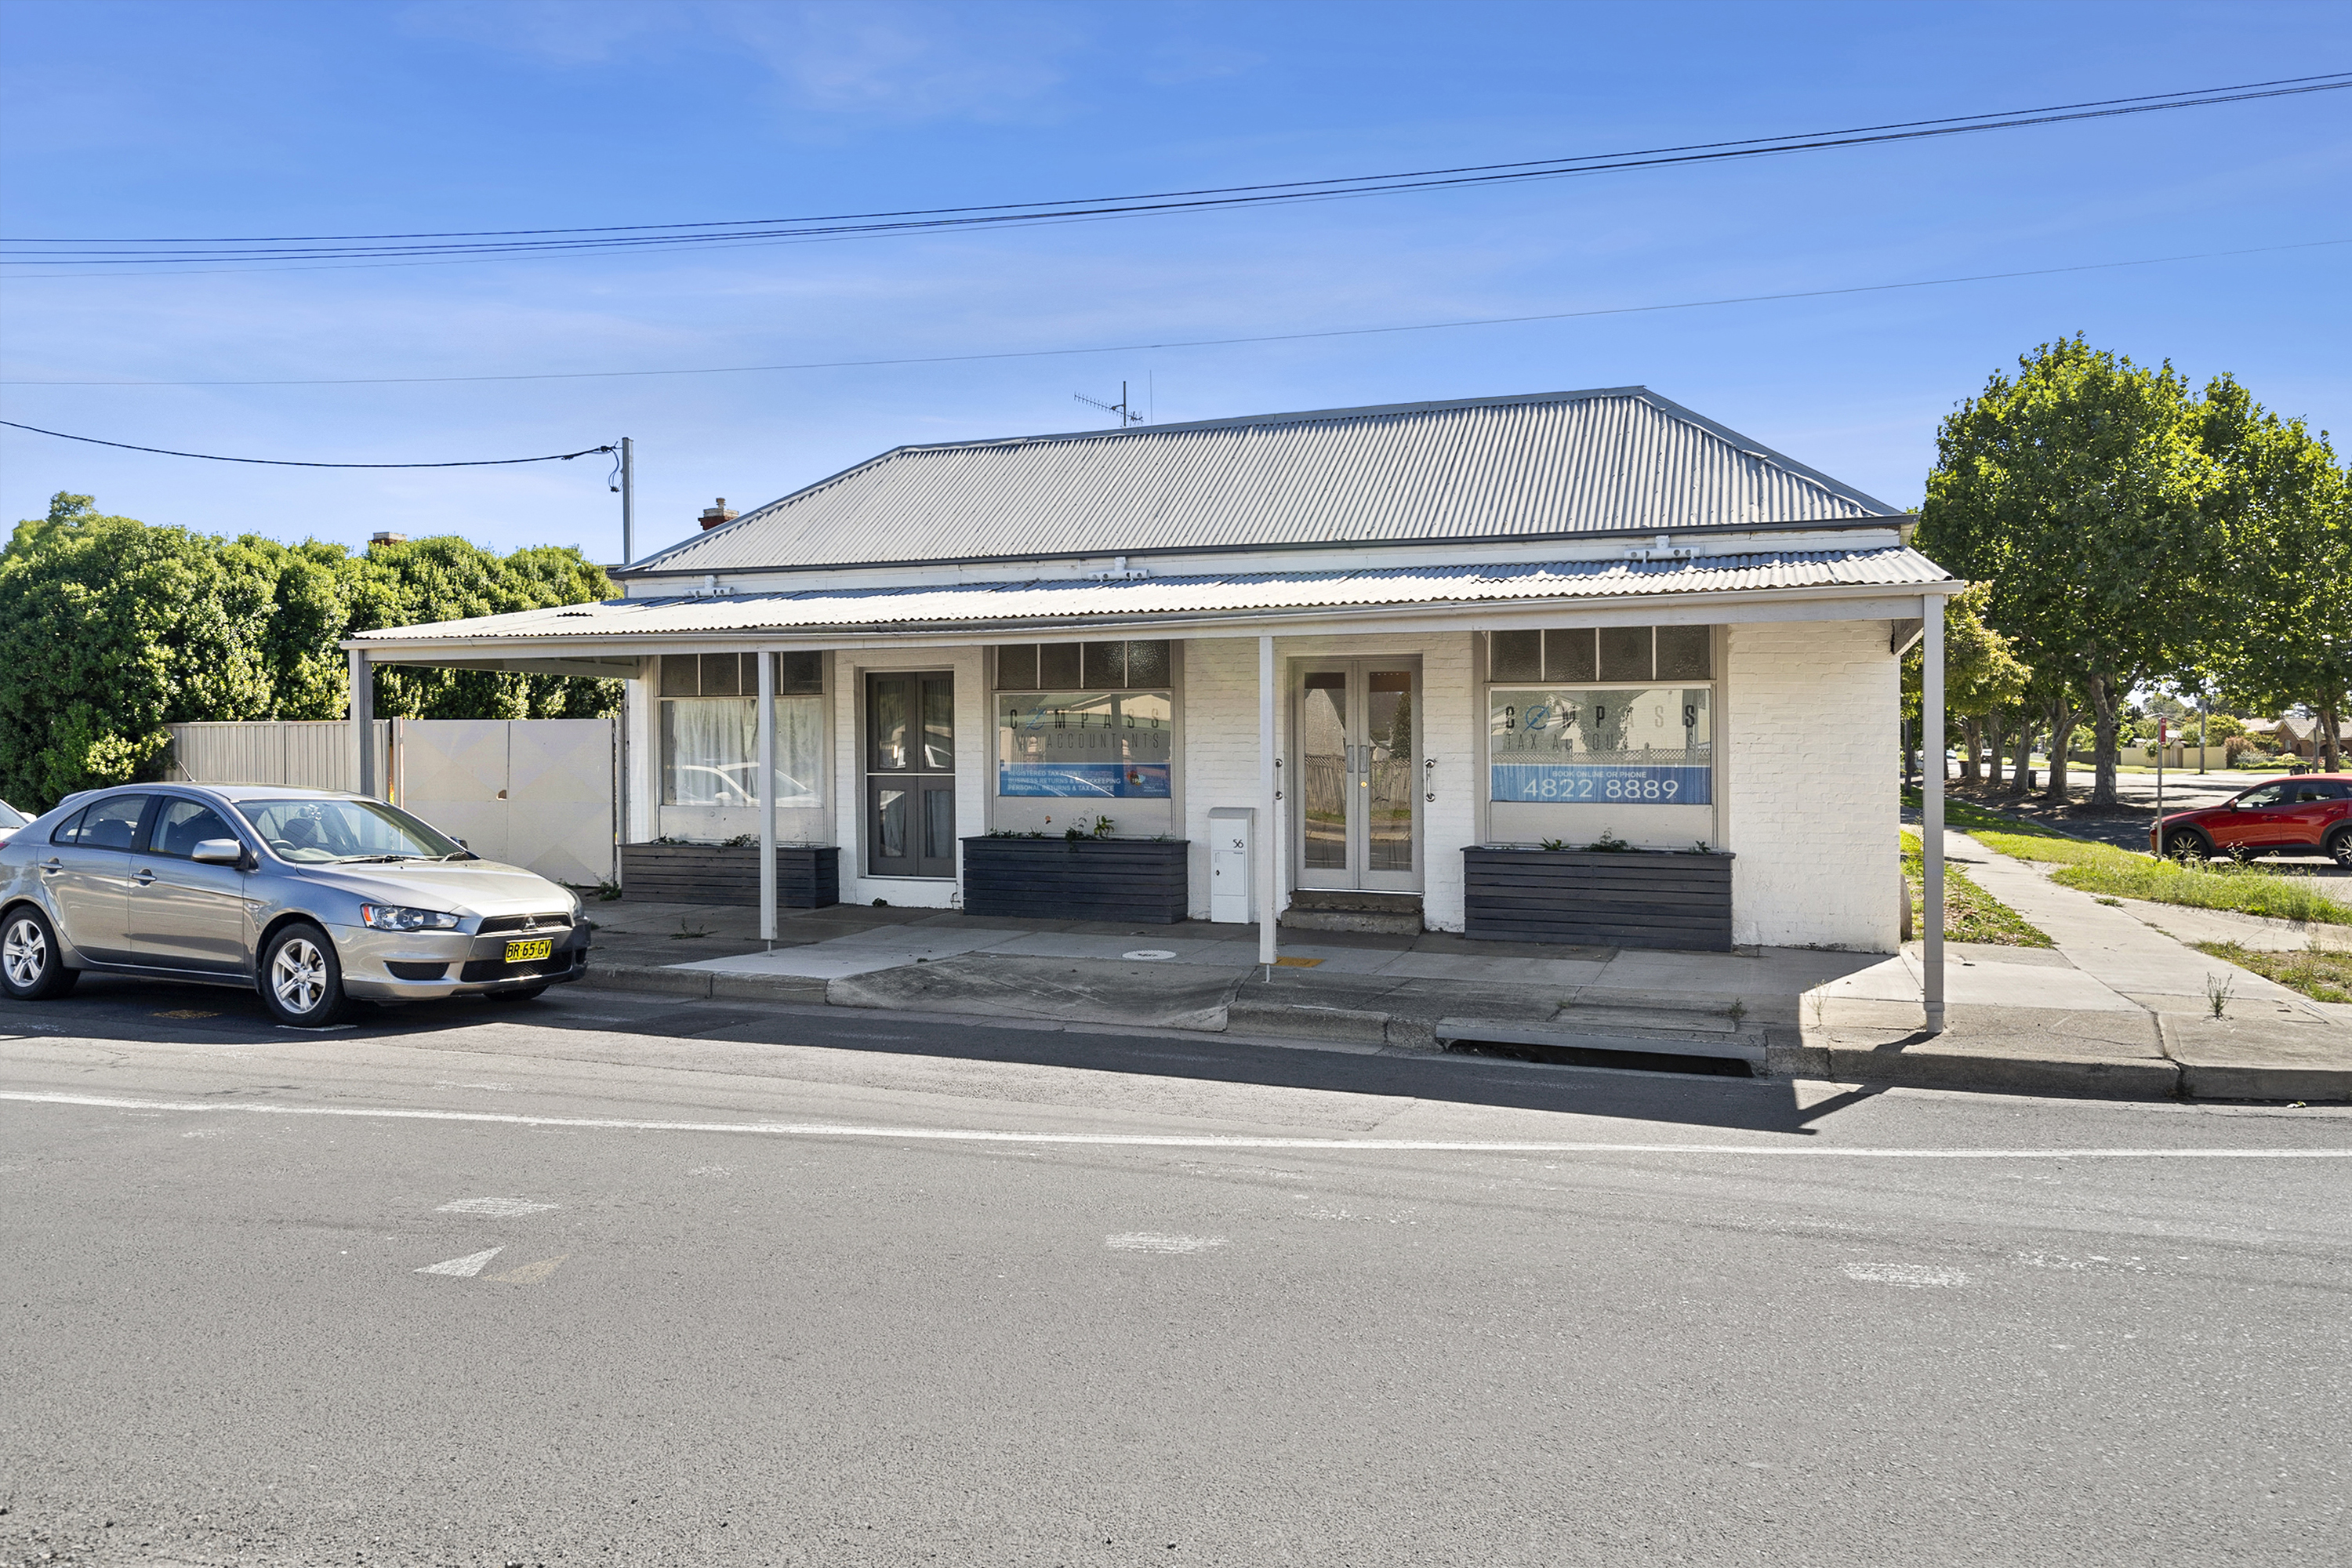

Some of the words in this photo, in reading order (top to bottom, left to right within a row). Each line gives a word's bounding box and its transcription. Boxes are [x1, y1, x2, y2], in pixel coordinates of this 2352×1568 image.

[1506, 734, 1537, 750] TAX
[1523, 779, 1593, 798] 4822
[1606, 779, 1679, 799] 8889
[1232, 839, 1244, 848] 56
